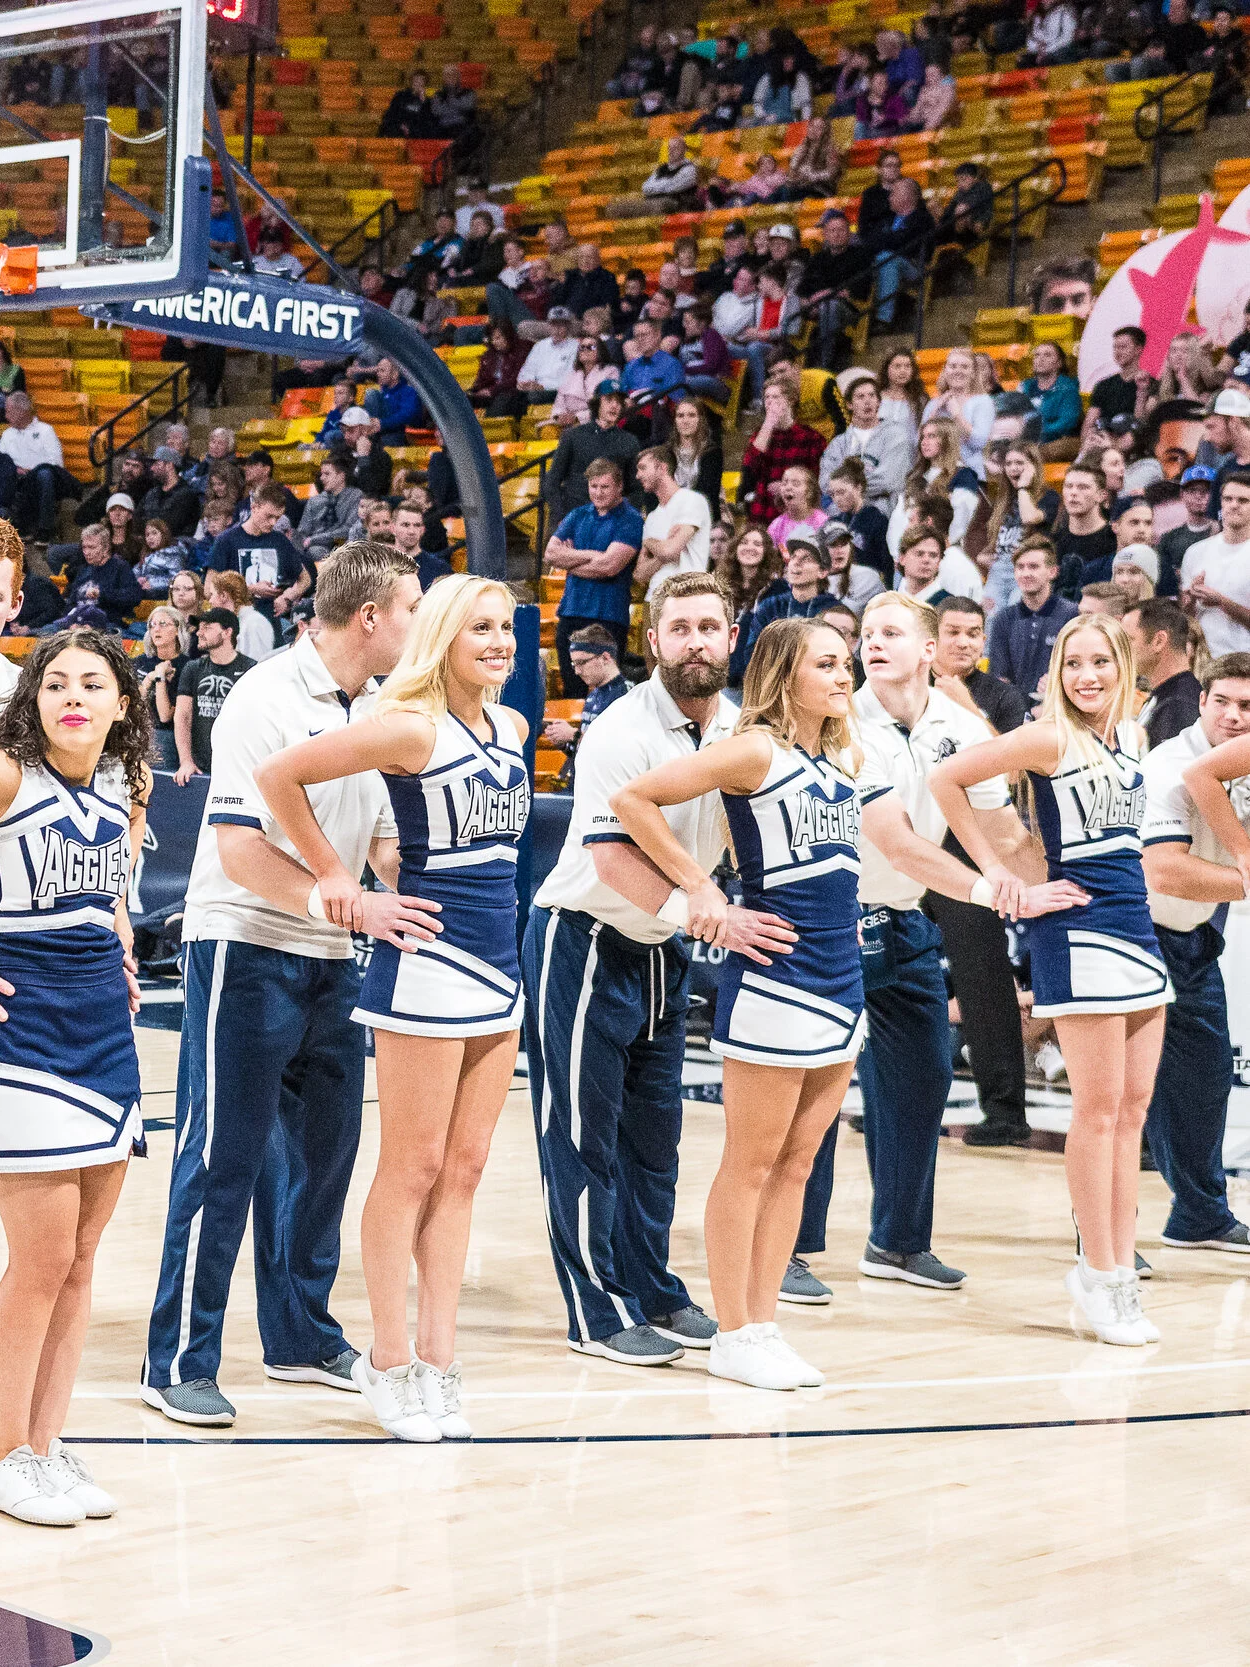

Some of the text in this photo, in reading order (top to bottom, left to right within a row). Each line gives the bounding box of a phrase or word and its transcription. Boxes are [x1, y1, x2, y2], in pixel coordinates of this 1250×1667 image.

[132, 287, 360, 341] AMERICA FIRST
[198, 707, 220, 718] AGG
[224, 796, 245, 805] STATE
[792, 789, 862, 850] AGGIES
[1085, 777, 1147, 829] AGGIE
[35, 828, 130, 899] AGGIES
[691, 940, 730, 965] LO
